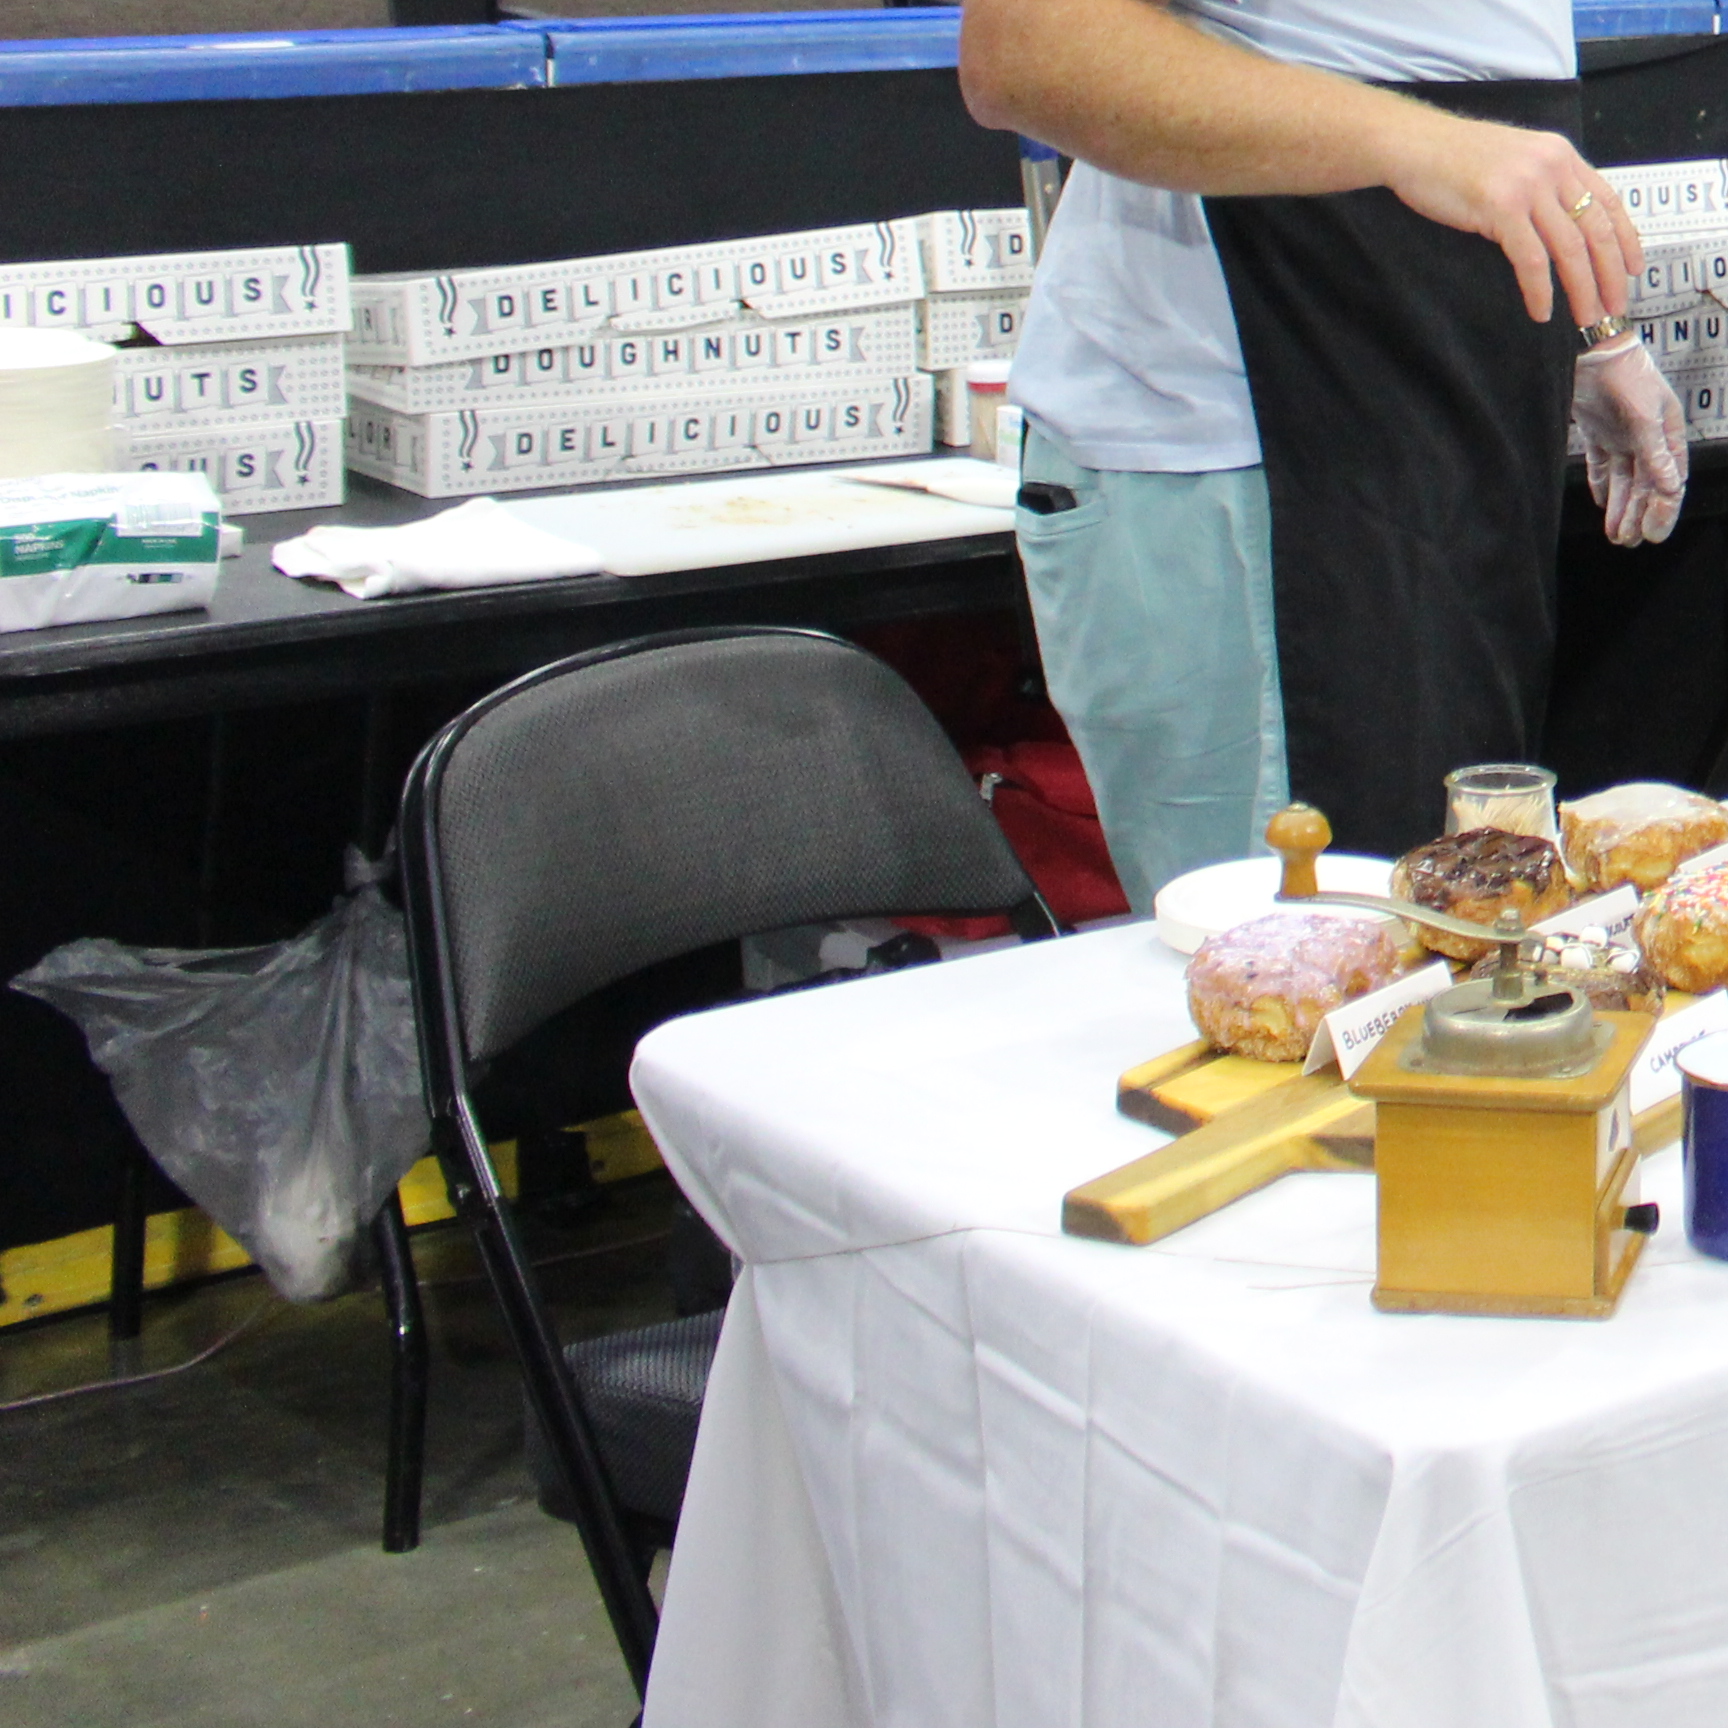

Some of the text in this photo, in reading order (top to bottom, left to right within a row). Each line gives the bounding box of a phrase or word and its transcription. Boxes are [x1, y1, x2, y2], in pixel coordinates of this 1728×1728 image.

[498, 251, 848, 319] DELICIOUS
[493, 328, 843, 374] DOUGHNUTS
[516, 405, 861, 456] DELICIOUS
